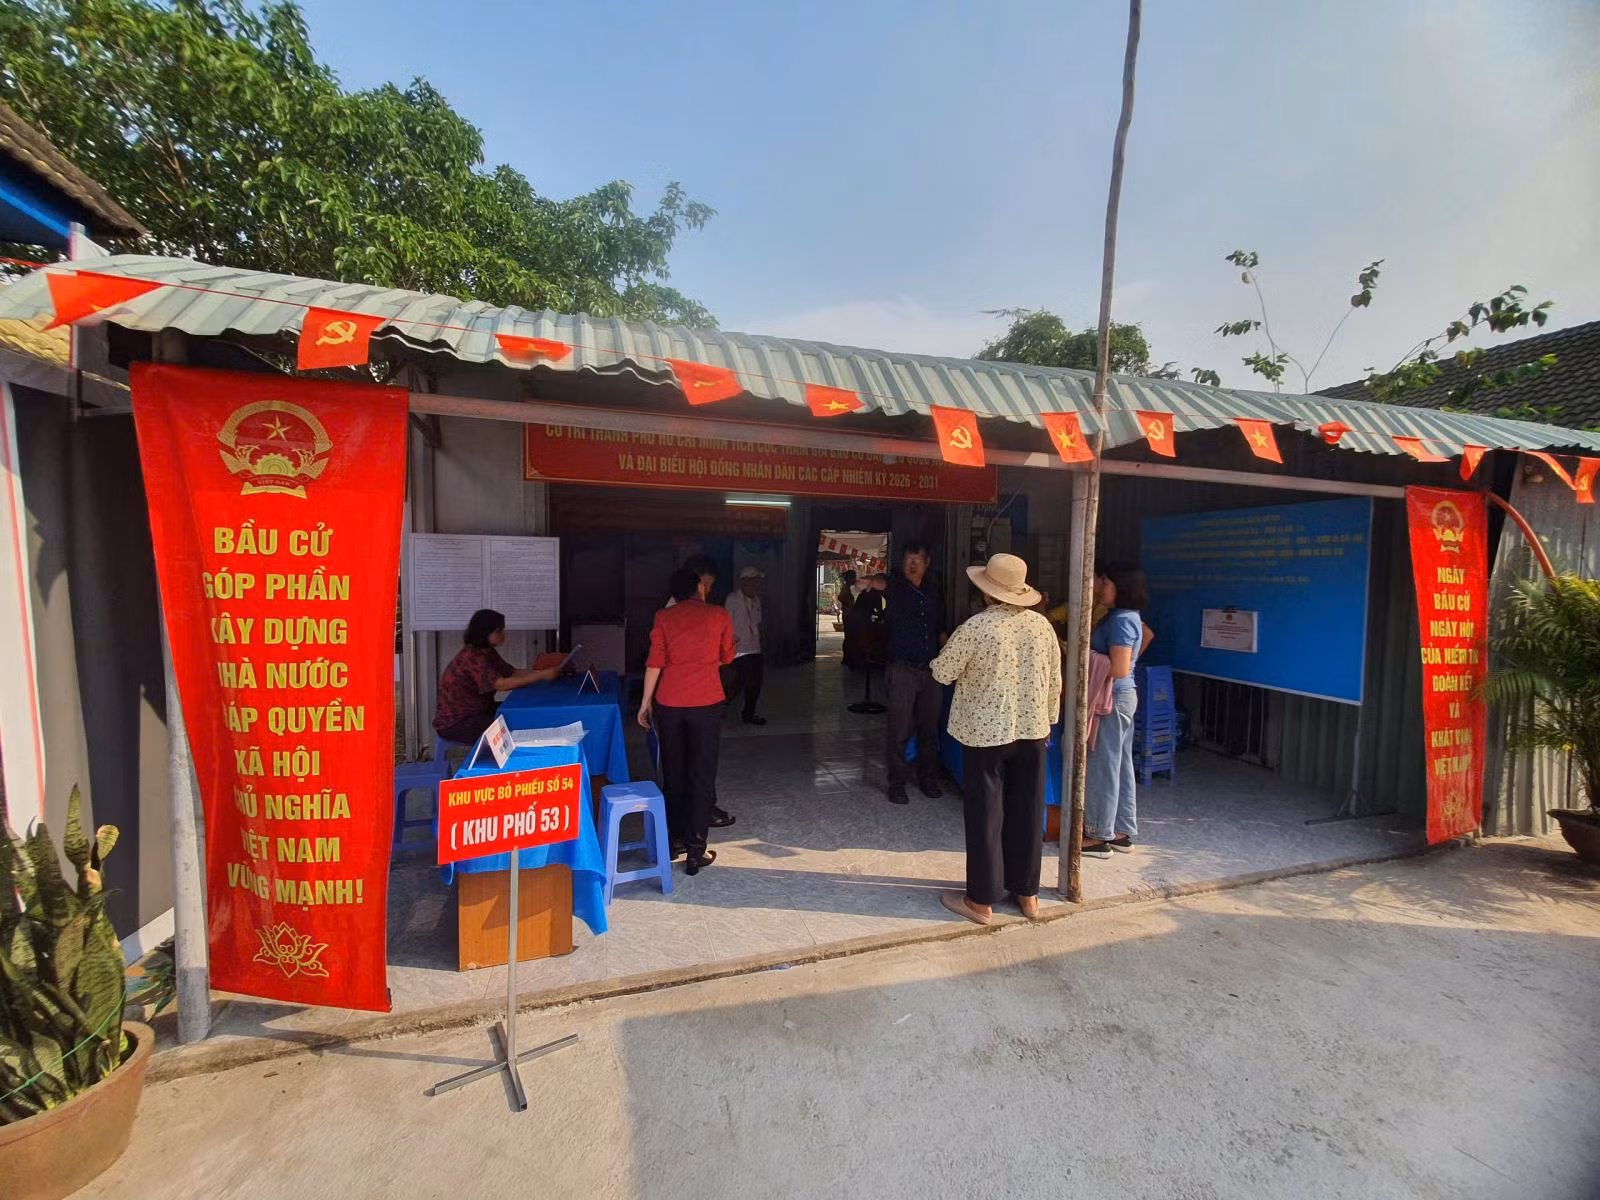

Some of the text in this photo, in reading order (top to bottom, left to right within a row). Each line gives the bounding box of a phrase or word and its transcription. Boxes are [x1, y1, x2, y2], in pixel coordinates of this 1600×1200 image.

[619, 451, 634, 470] VÀ
[637, 455, 656, 475] ĐẠI
[660, 452, 685, 474] BIỂU
[689, 456, 707, 478] HỘI
[710, 456, 739, 477] ĐỒNG
[775, 462, 795, 480] DÂN
[798, 463, 818, 481] CÁC
[820, 464, 839, 483] CẤP
[889, 473, 911, 488] 2026
[919, 475, 939, 489] 2031
[214, 518, 332, 556] BẦU CỬ
[202, 566, 350, 601] GÓP PHẦN
[1437, 565, 1464, 584] NGÀY
[1457, 590, 1471, 611] CỬ
[264, 617, 347, 650] DỰNG
[1430, 618, 1474, 641] NGÀY HỘI
[1421, 642, 1441, 664] CỦA
[266, 658, 348, 688] NƯỚC
[268, 698, 364, 736] QUYỀN
[1449, 699, 1460, 719] VÀ
[234, 746, 320, 782] XÃ HỘI
[265, 788, 351, 820] NGHĨA
[448, 774, 574, 807] KHU VỰC BỎ PHIẾU SỐ 54
[463, 818, 498, 846] KHU
[503, 802, 536, 839] PHỐ
[540, 806, 560, 832] 53
[277, 837, 340, 863] NAM
[275, 879, 363, 911] MẠNH!
